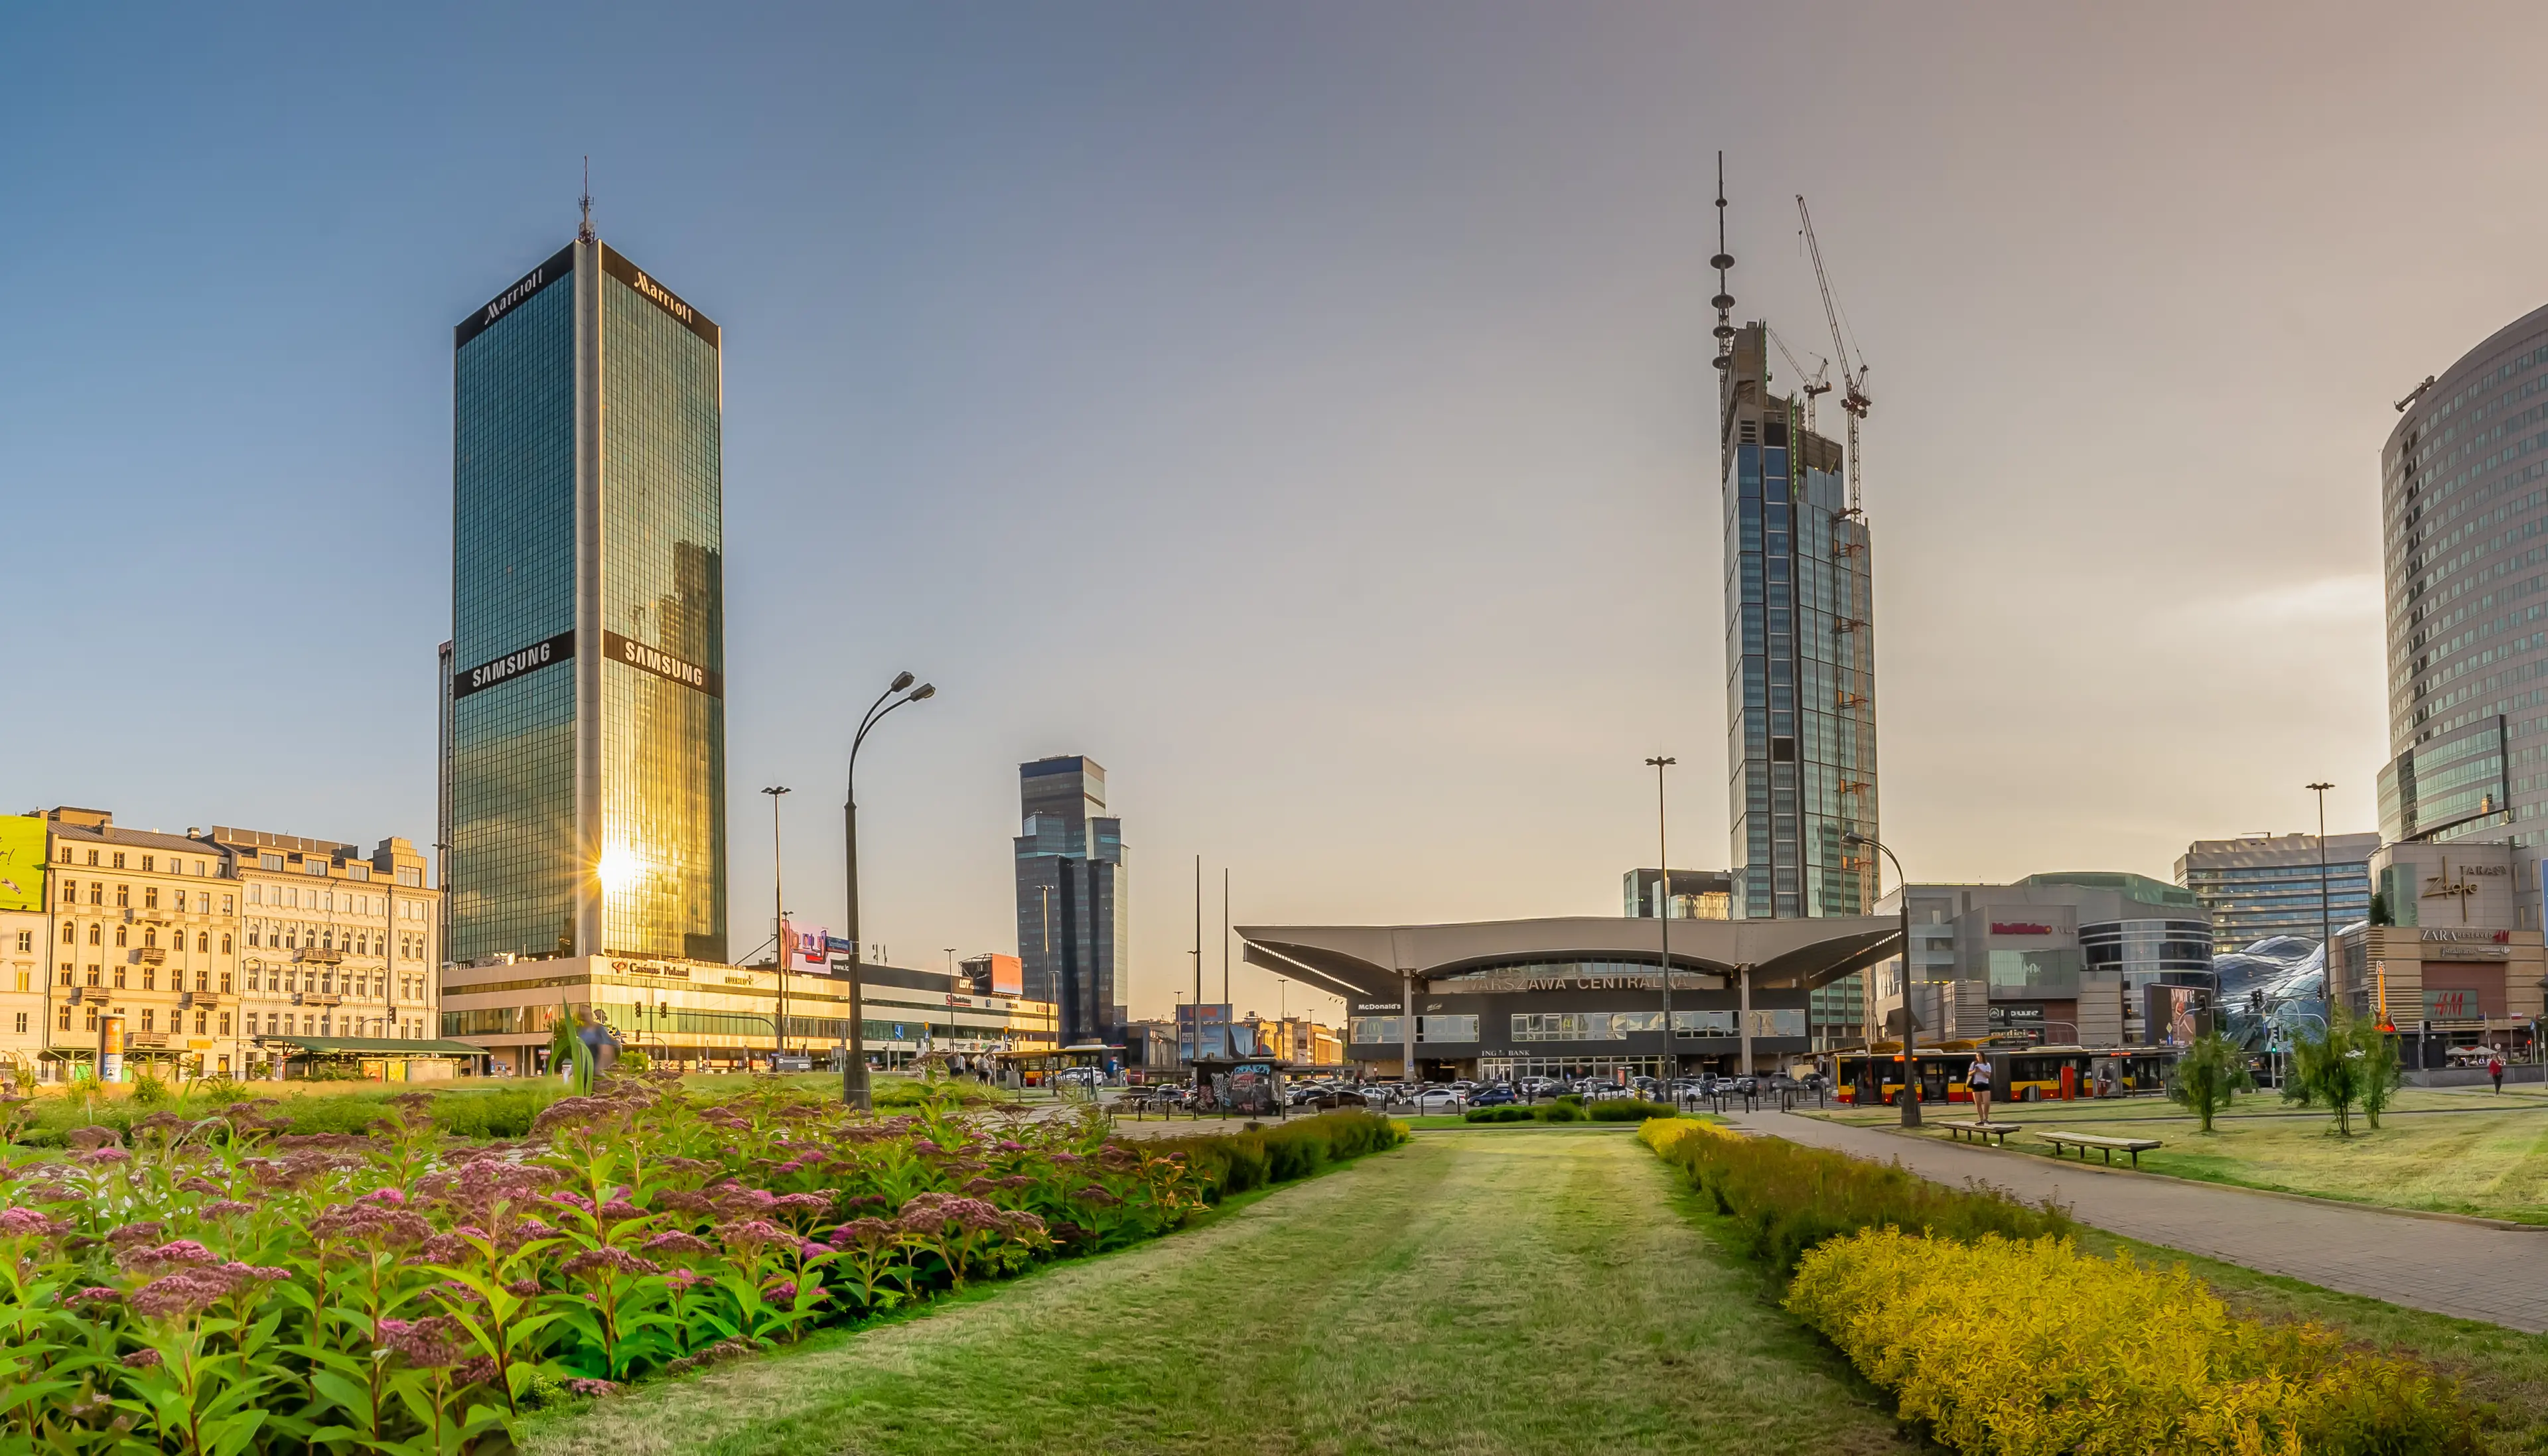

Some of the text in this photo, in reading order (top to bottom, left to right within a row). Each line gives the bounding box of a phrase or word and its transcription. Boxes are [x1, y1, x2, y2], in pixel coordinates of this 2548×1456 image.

[484, 268, 542, 325] Marriott
[634, 271, 692, 324] Marriott
[472, 643, 549, 687] SAMSUNG
[625, 641, 702, 686] SAMSUNG
[2460, 866, 2508, 876] TARASY
[2422, 929, 2457, 941] ZARA
[664, 966, 689, 976] Poland
[959, 979, 970, 988] LOT
[1462, 977, 1566, 990] WARSZAWA
